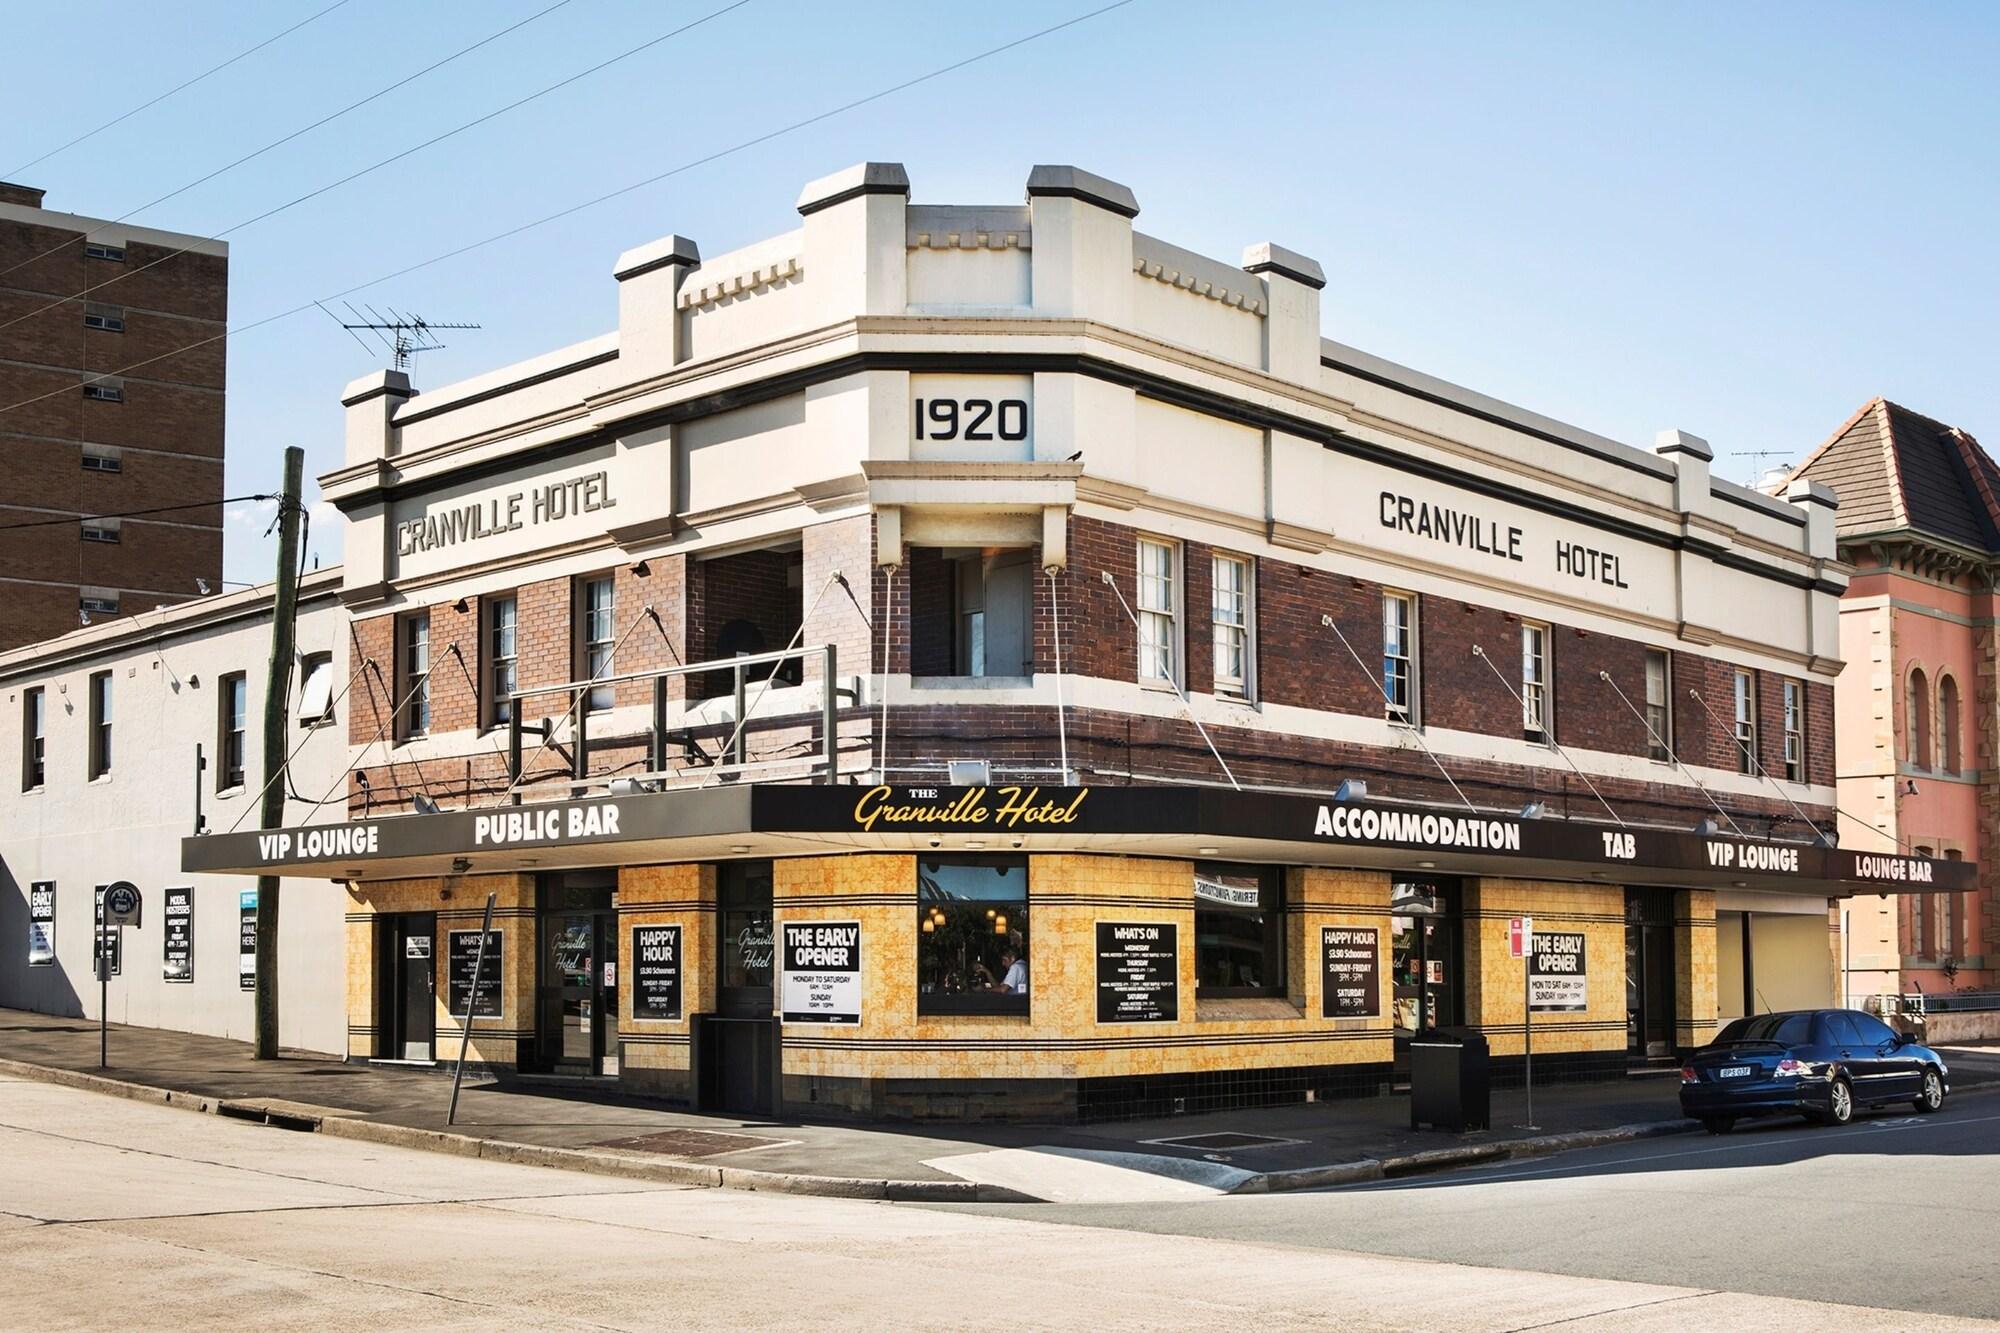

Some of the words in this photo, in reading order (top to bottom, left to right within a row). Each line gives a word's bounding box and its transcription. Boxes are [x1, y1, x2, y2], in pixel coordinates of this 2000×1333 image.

[915, 398, 1027, 441] 1920
[532, 471, 617, 525] HOTEL
[1556, 540, 1629, 589] HOTEL
[909, 789, 938, 798] THE
[854, 785, 989, 832] Granville
[995, 786, 1089, 828] Hotel
[475, 809, 560, 845] PUBLIC
[568, 804, 620, 837] BAR
[1314, 805, 1520, 850] ACCOMMODATION
[259, 834, 291, 860] VIP
[297, 826, 378, 858] LOUNGE
[1602, 832, 1637, 859] TAB
[1707, 841, 1734, 867] VIP
[1738, 845, 1799, 872] LOUNGE
[1855, 855, 1906, 880] LOUNGE
[1909, 861, 1933, 882] BAR
[32, 892, 53, 907] EARLY
[32, 906, 52, 917] OPENER
[640, 931, 676, 946] HAPPY
[787, 928, 813, 947] THE
[816, 927, 858, 947] EARLY
[1146, 928, 1159, 940] ON
[1324, 931, 1352, 945] HAPPY
[1353, 932, 1376, 945] HOUR
[1532, 935, 1552, 953] THE
[1553, 936, 1582, 954] EARLY
[643, 946, 673, 962] HOUR
[743, 949, 773, 970] Hotel
[796, 948, 849, 966] OPENER
[1538, 954, 1577, 972] OPENER
[824, 976, 851, 984] SATURDAY
[1532, 981, 1544, 989] MON
[1552, 981, 1562, 989] SAT
[1336, 988, 1365, 998] SATURDAY
[1536, 991, 1555, 1000] SUNDAY
